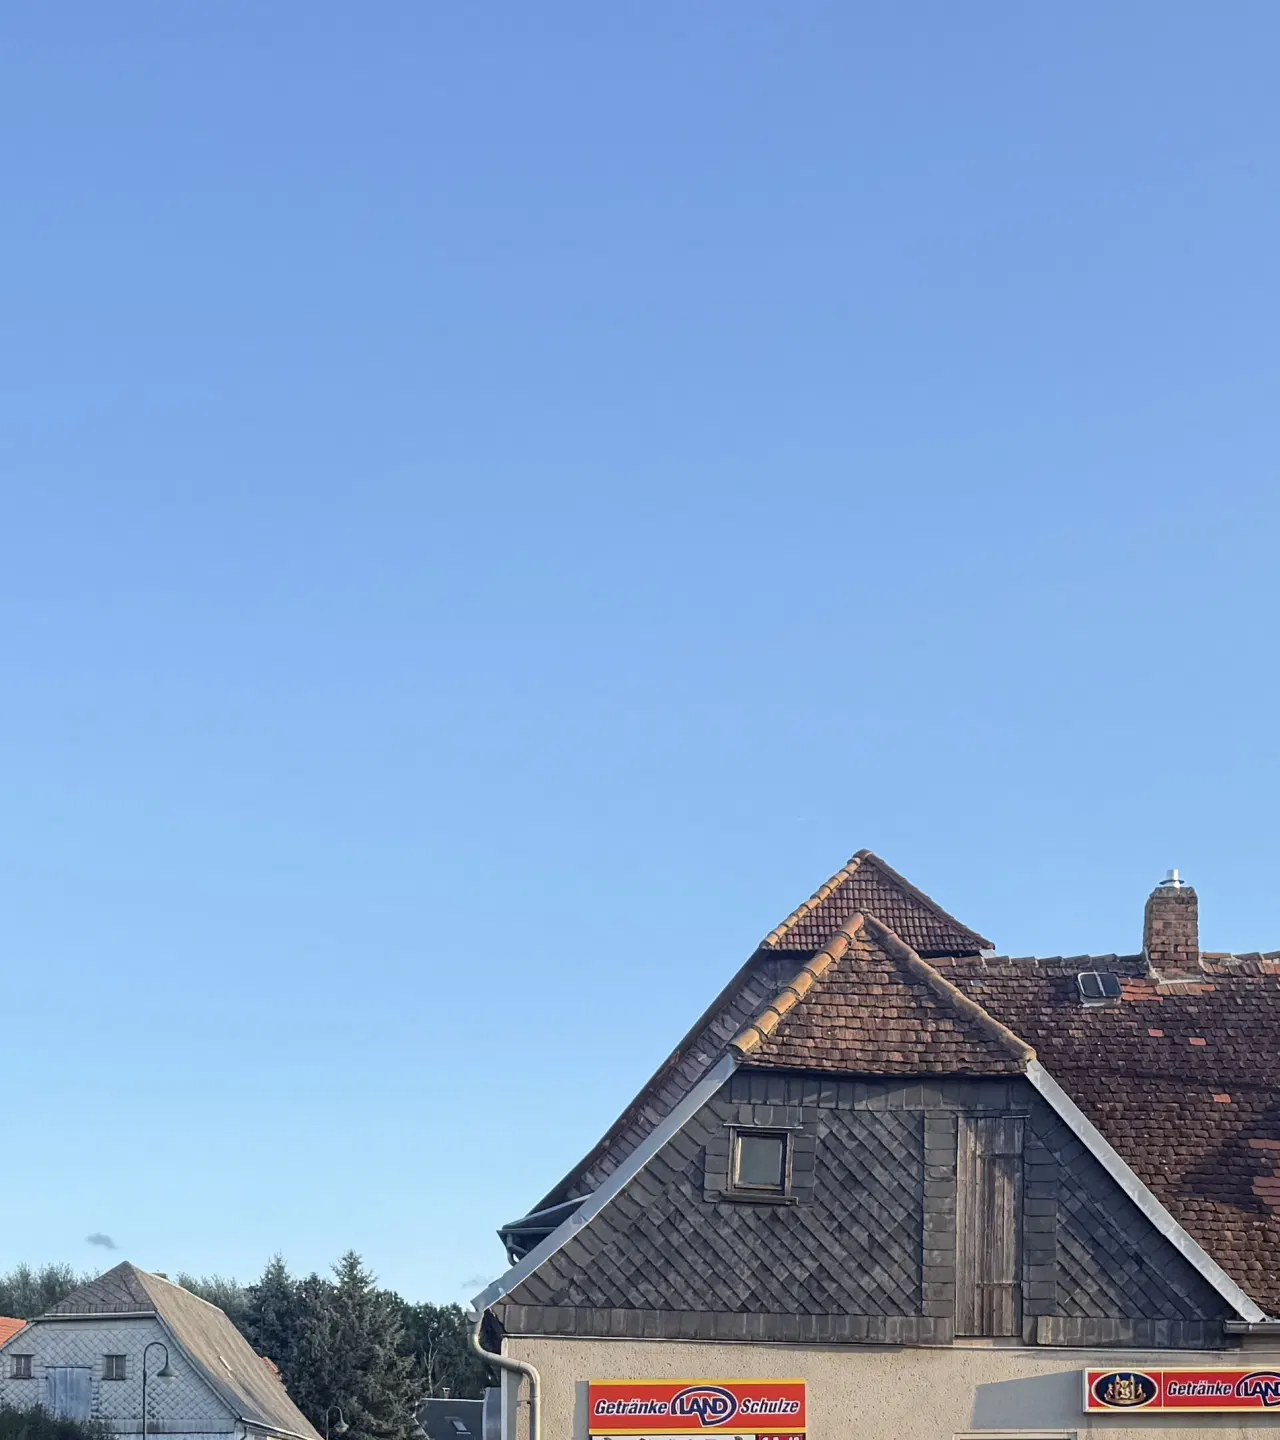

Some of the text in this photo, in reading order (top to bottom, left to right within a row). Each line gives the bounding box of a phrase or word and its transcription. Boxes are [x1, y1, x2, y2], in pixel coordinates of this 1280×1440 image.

[1168, 1380, 1232, 1396] Getränke
[594, 1397, 800, 1415] Getränke LAND Schulze
